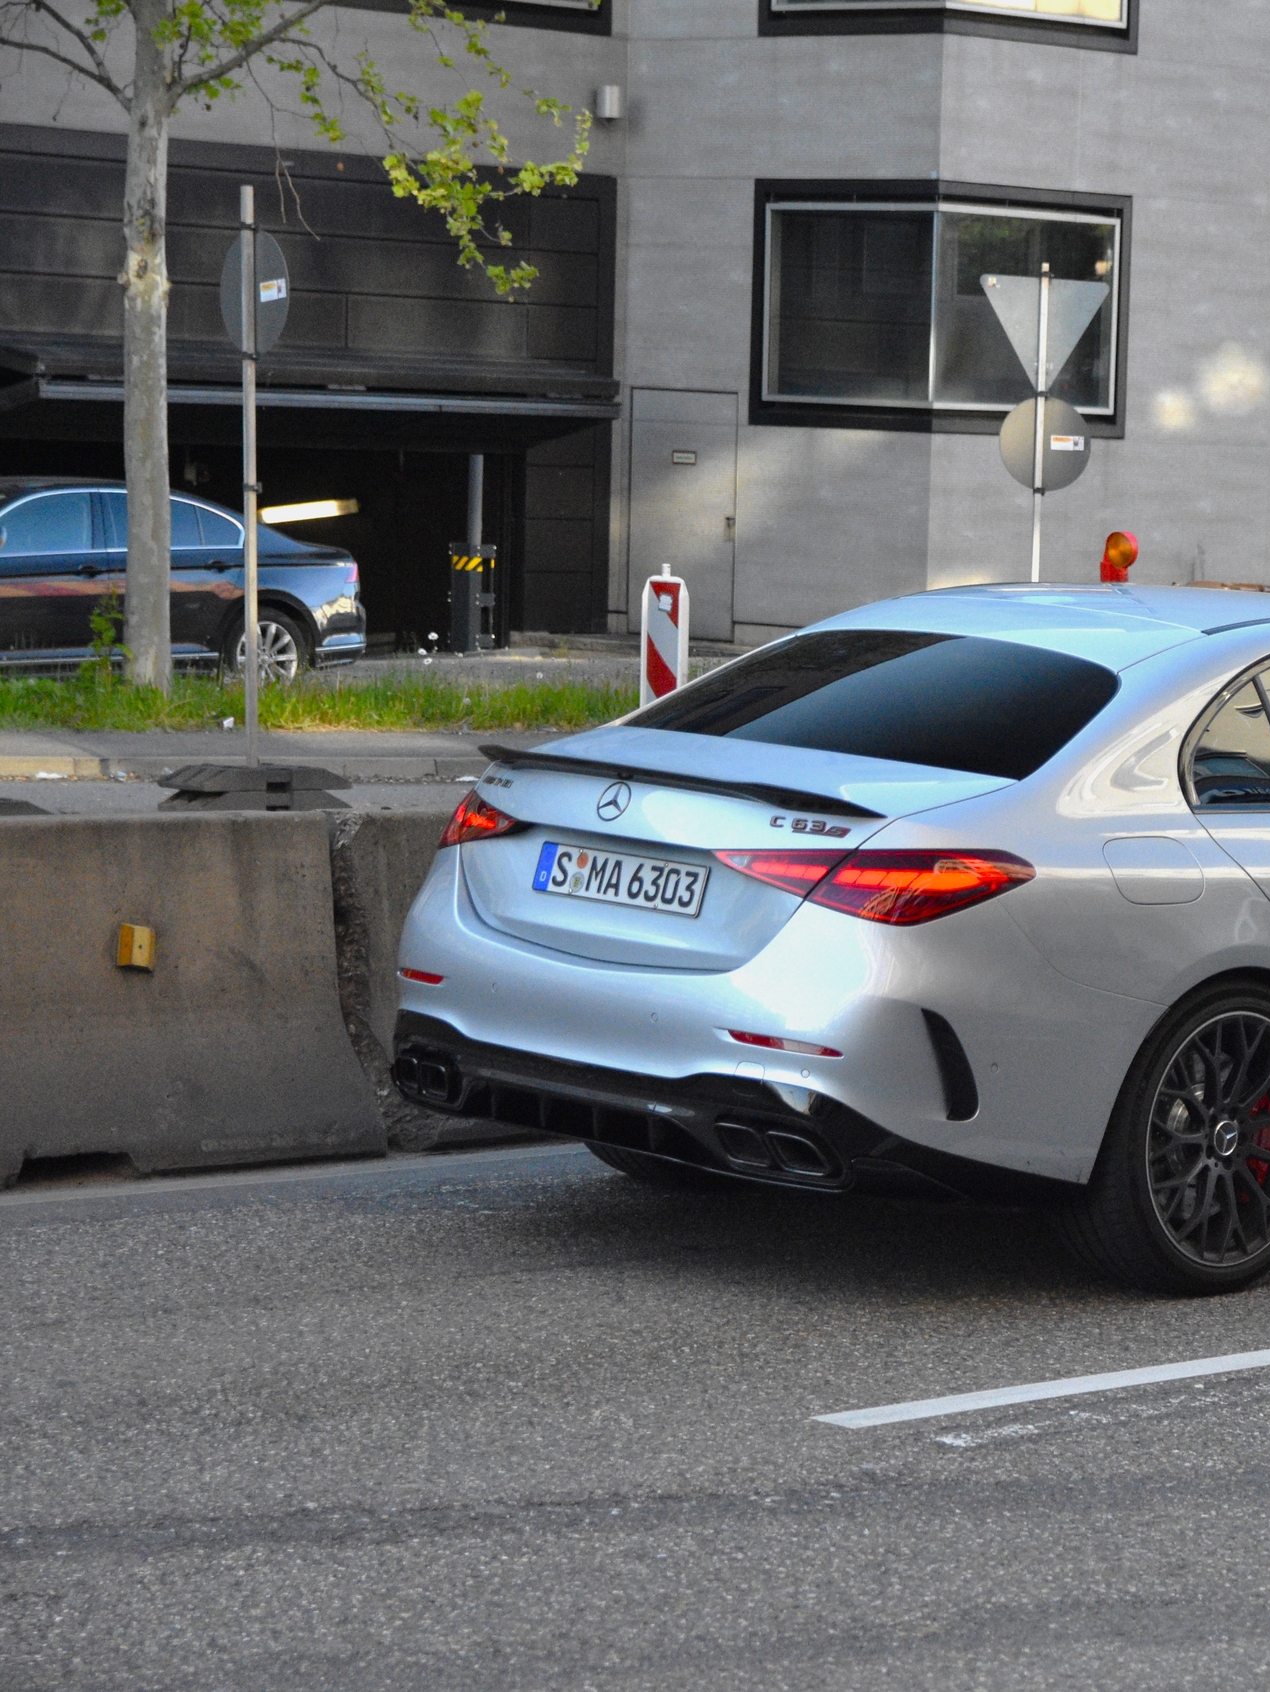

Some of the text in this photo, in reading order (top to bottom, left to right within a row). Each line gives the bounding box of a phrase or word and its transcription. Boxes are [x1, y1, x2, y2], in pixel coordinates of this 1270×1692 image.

[770, 815, 786, 828] C
[539, 870, 547, 882] D
[551, 851, 700, 909] S MA 6303
